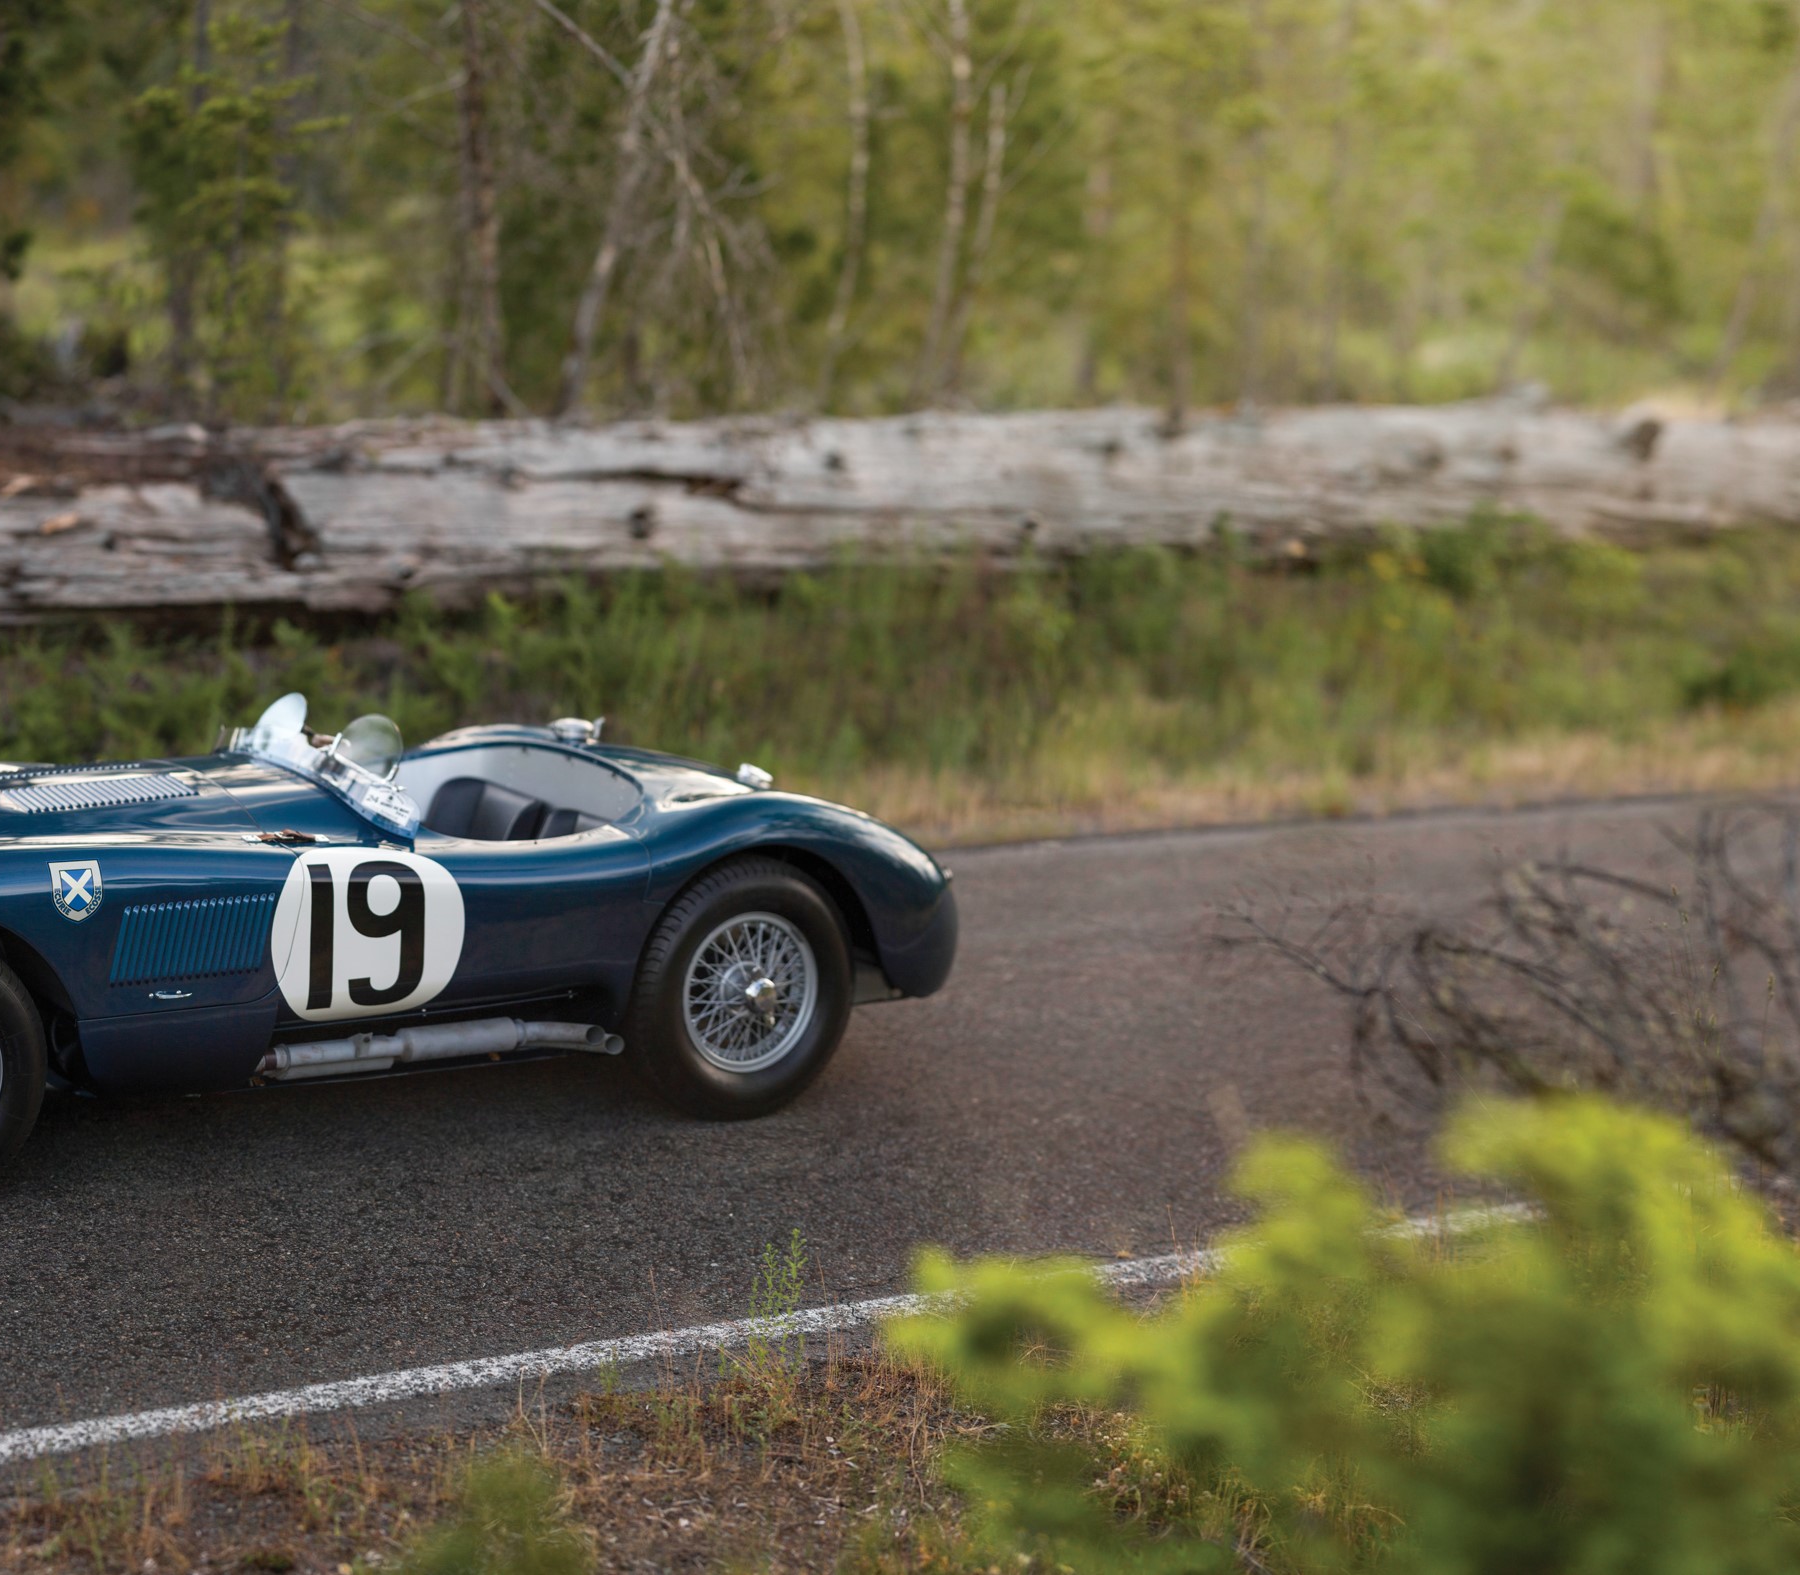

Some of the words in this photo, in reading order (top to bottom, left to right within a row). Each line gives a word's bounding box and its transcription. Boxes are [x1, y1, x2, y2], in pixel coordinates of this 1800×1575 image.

[54, 888, 71, 915] ECURIE
[85, 886, 101, 914] ECOSSE
[306, 861, 426, 1010] 19
